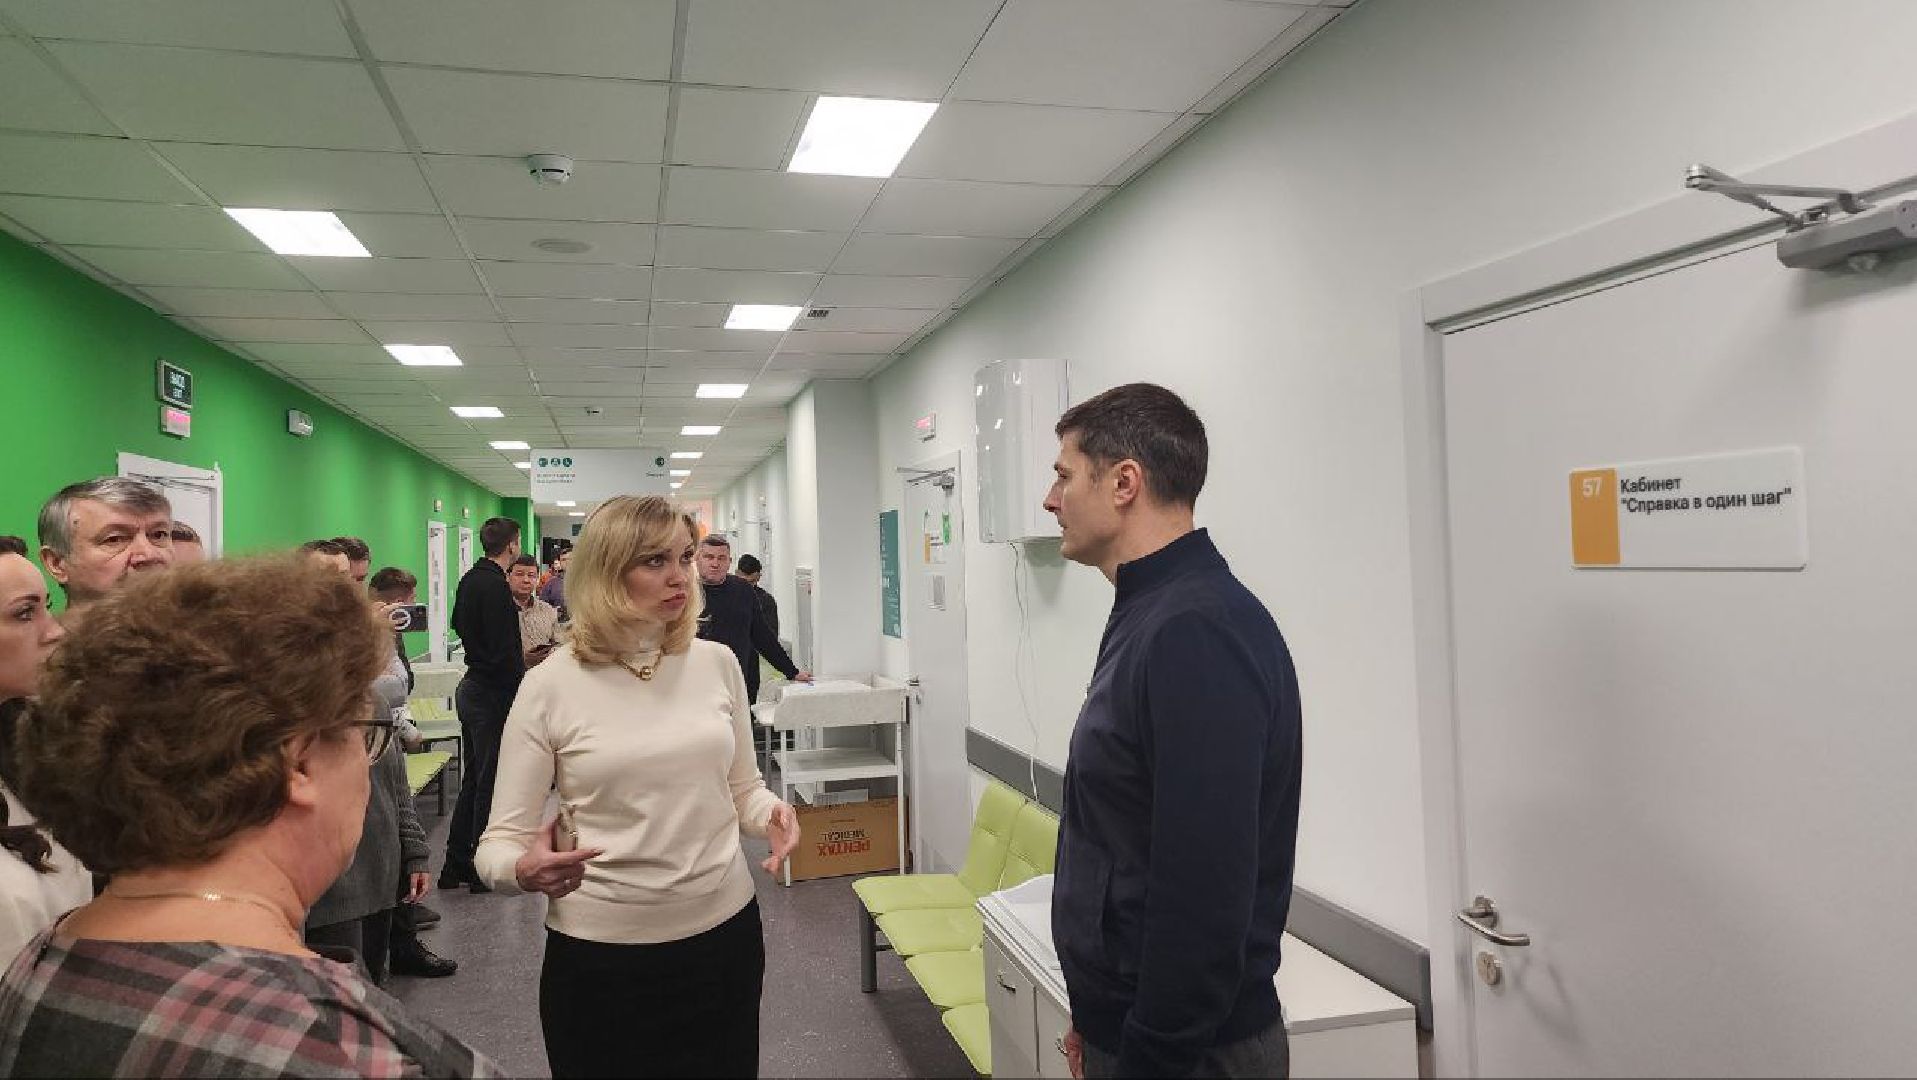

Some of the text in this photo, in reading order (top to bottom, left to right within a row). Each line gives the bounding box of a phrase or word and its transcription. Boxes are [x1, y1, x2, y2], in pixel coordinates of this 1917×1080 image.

[1581, 477, 1603, 497] 57
[1620, 476, 1682, 493] Кабинет
[1621, 487, 1792, 515] "Справка в один шаг"
[821, 829, 865, 841] MEDICAL
[816, 839, 871, 856] PENTAX
